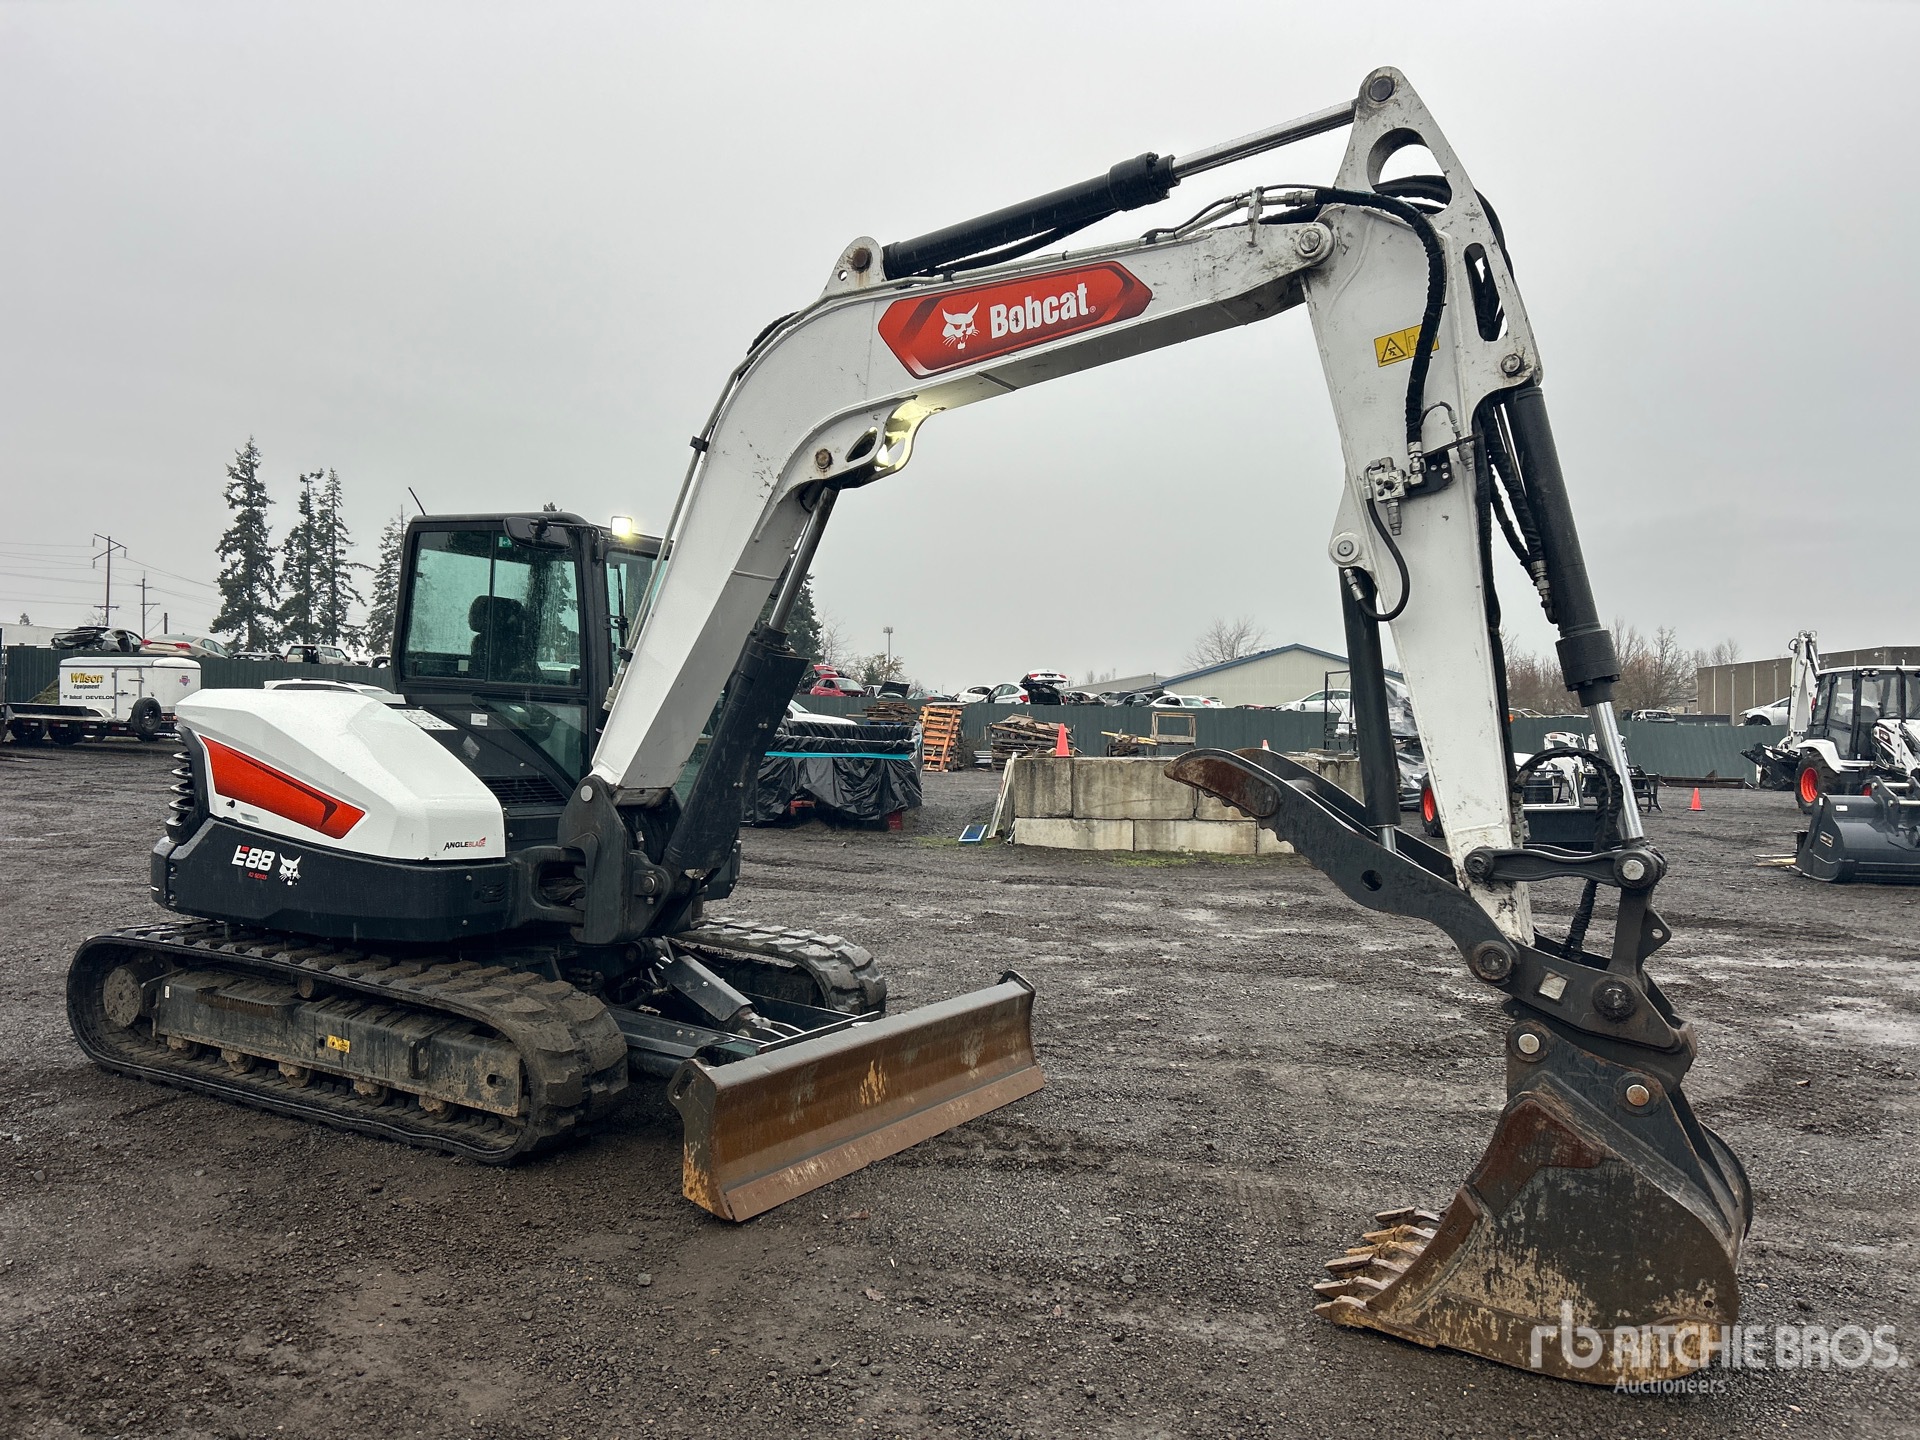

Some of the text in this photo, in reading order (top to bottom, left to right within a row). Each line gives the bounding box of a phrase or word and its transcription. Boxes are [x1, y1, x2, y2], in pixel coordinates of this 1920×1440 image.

[990, 283, 1089, 339] Bobcat
[71, 673, 104, 684] Wilson
[231, 845, 276, 871] E88
